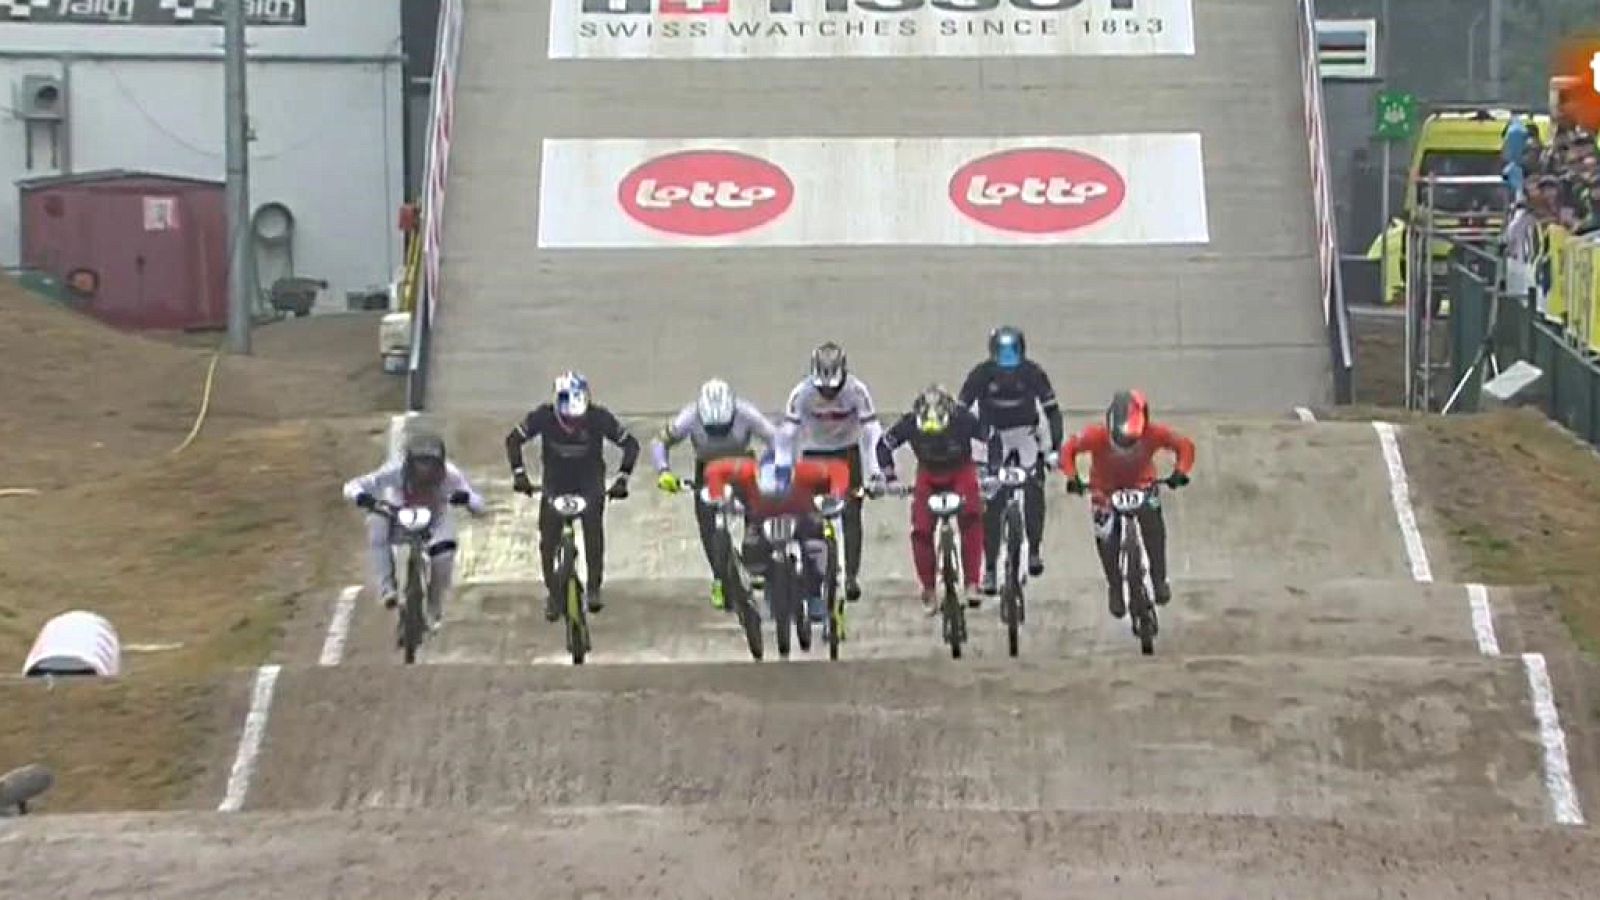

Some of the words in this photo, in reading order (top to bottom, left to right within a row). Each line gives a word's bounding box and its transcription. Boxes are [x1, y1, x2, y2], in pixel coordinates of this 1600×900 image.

[579, 21, 707, 38] SWISS
[728, 19, 917, 37] WATCHES
[940, 18, 1057, 36] SINCE
[1083, 18, 1164, 35] 1853
[635, 178, 776, 208] Lotto
[966, 174, 1108, 206] Lotto
